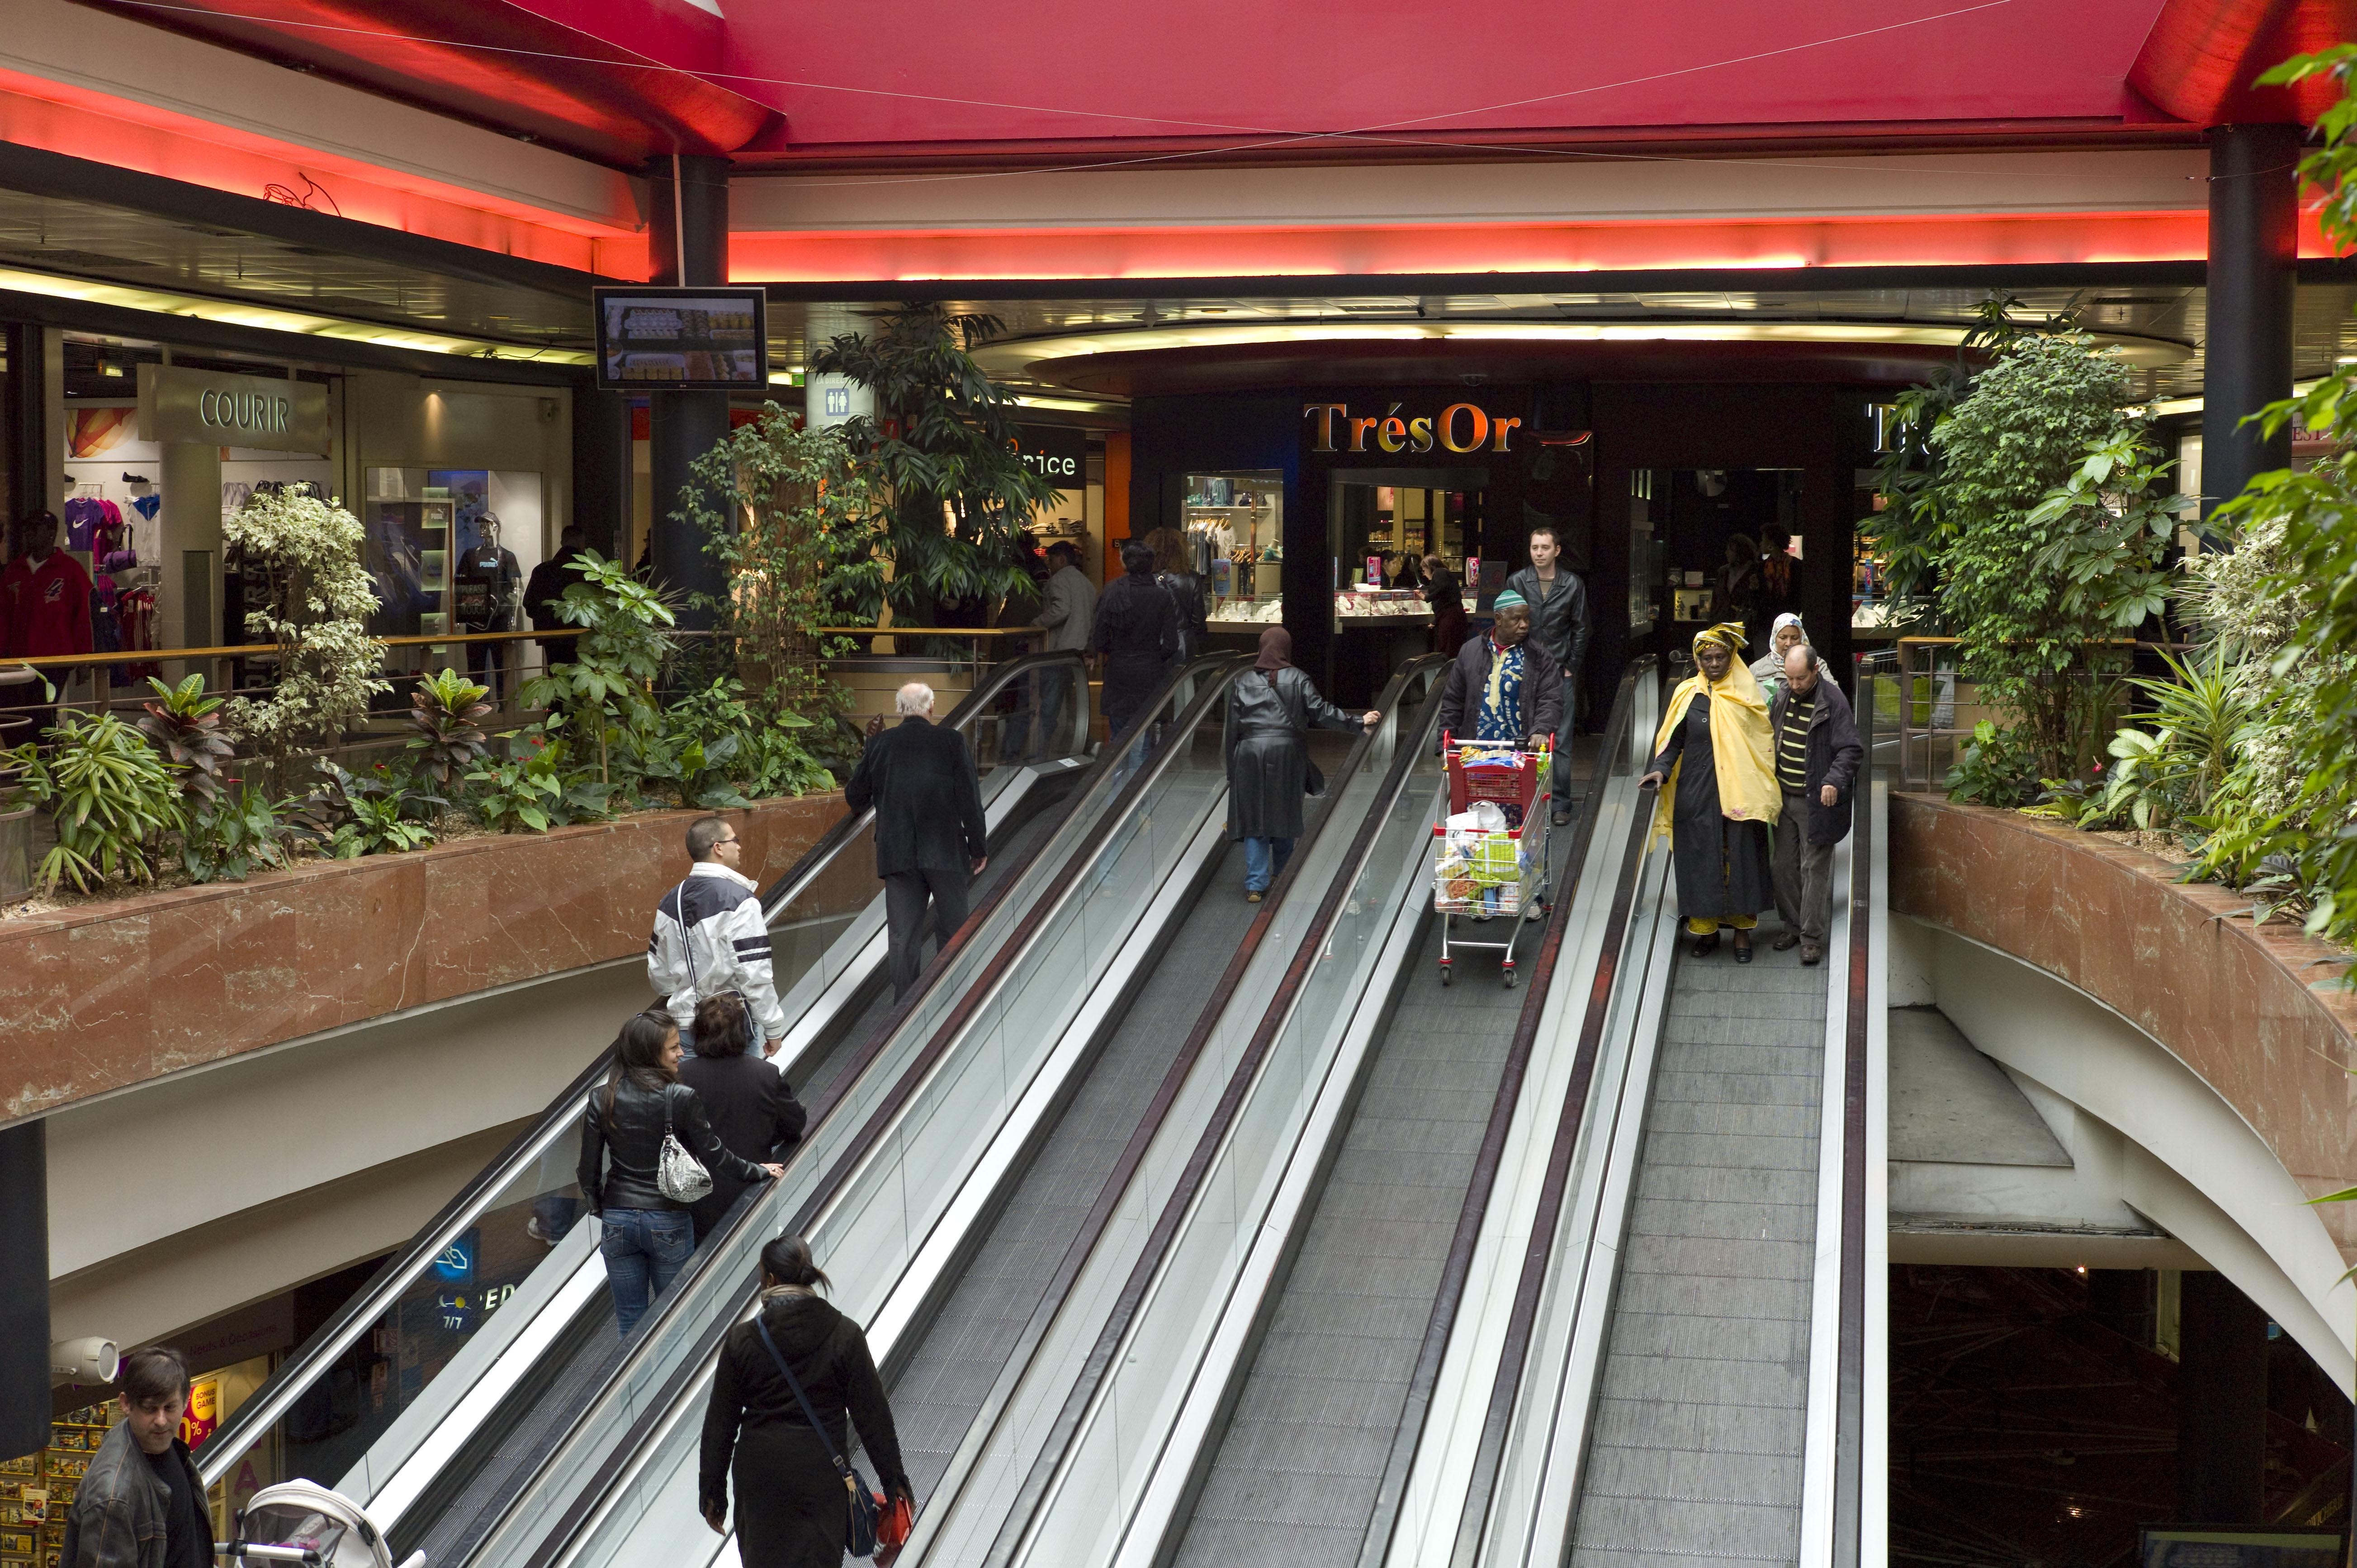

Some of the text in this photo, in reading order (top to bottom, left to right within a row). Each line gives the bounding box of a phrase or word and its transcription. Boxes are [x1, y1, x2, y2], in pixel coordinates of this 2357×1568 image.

[200, 388, 289, 433] COURIR
[1303, 402, 1521, 453] TrésOr
[443, 1316, 463, 1329] 7/7
[196, 1388, 216, 1400] BONUS
[196, 1397, 216, 1409] GAME
